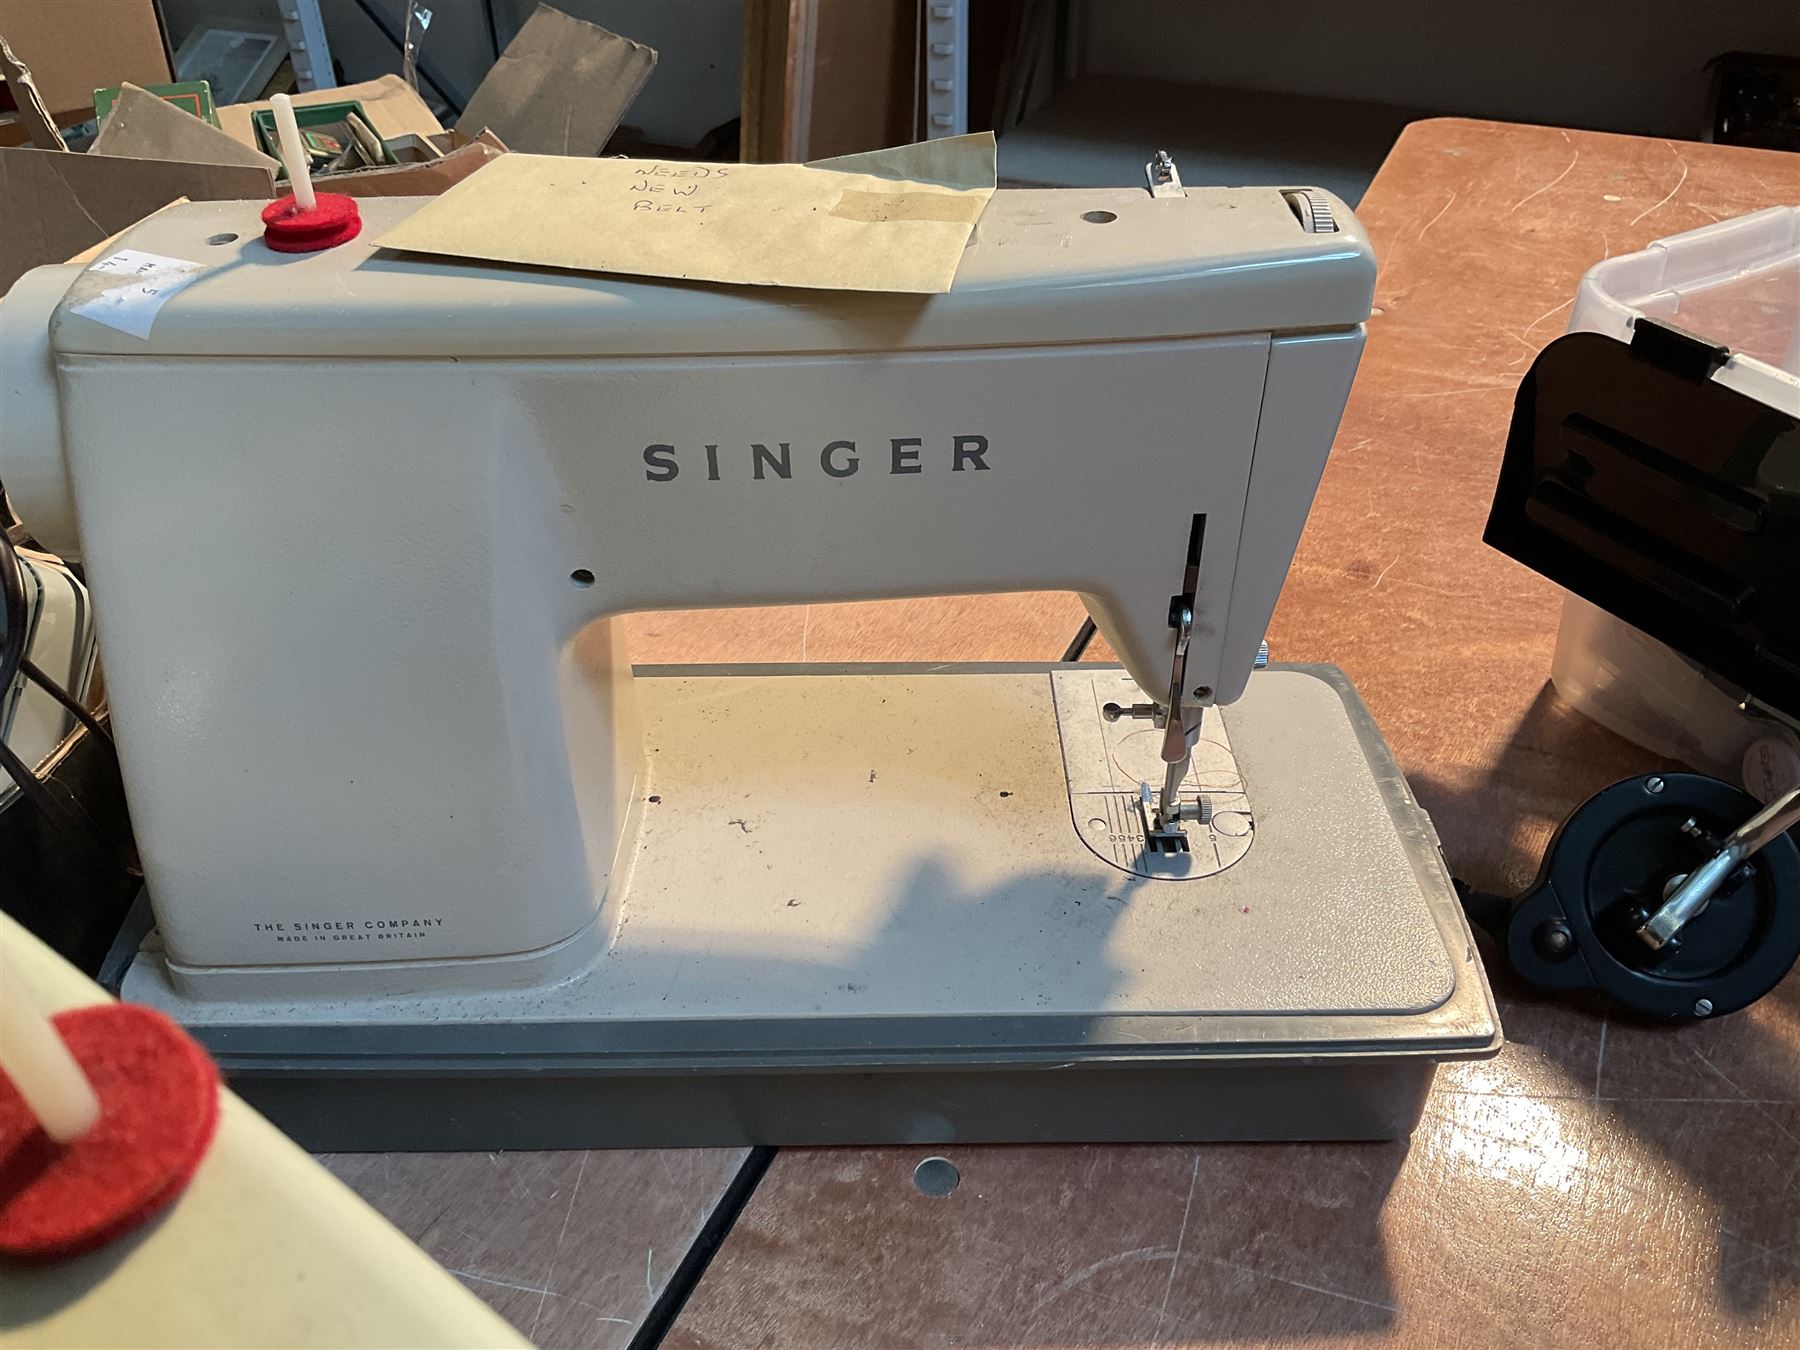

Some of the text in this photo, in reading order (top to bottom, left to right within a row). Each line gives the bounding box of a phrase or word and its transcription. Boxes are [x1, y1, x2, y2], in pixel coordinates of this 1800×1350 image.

[635, 165, 729, 179] NEEDS
[629, 180, 698, 197] NEW
[633, 199, 712, 214] BELT
[642, 434, 991, 482] SINGER
[254, 918, 443, 932] THE SINGER COMPANY
[333, 933, 371, 941] GREAT
[378, 932, 426, 940] BRITAIN
